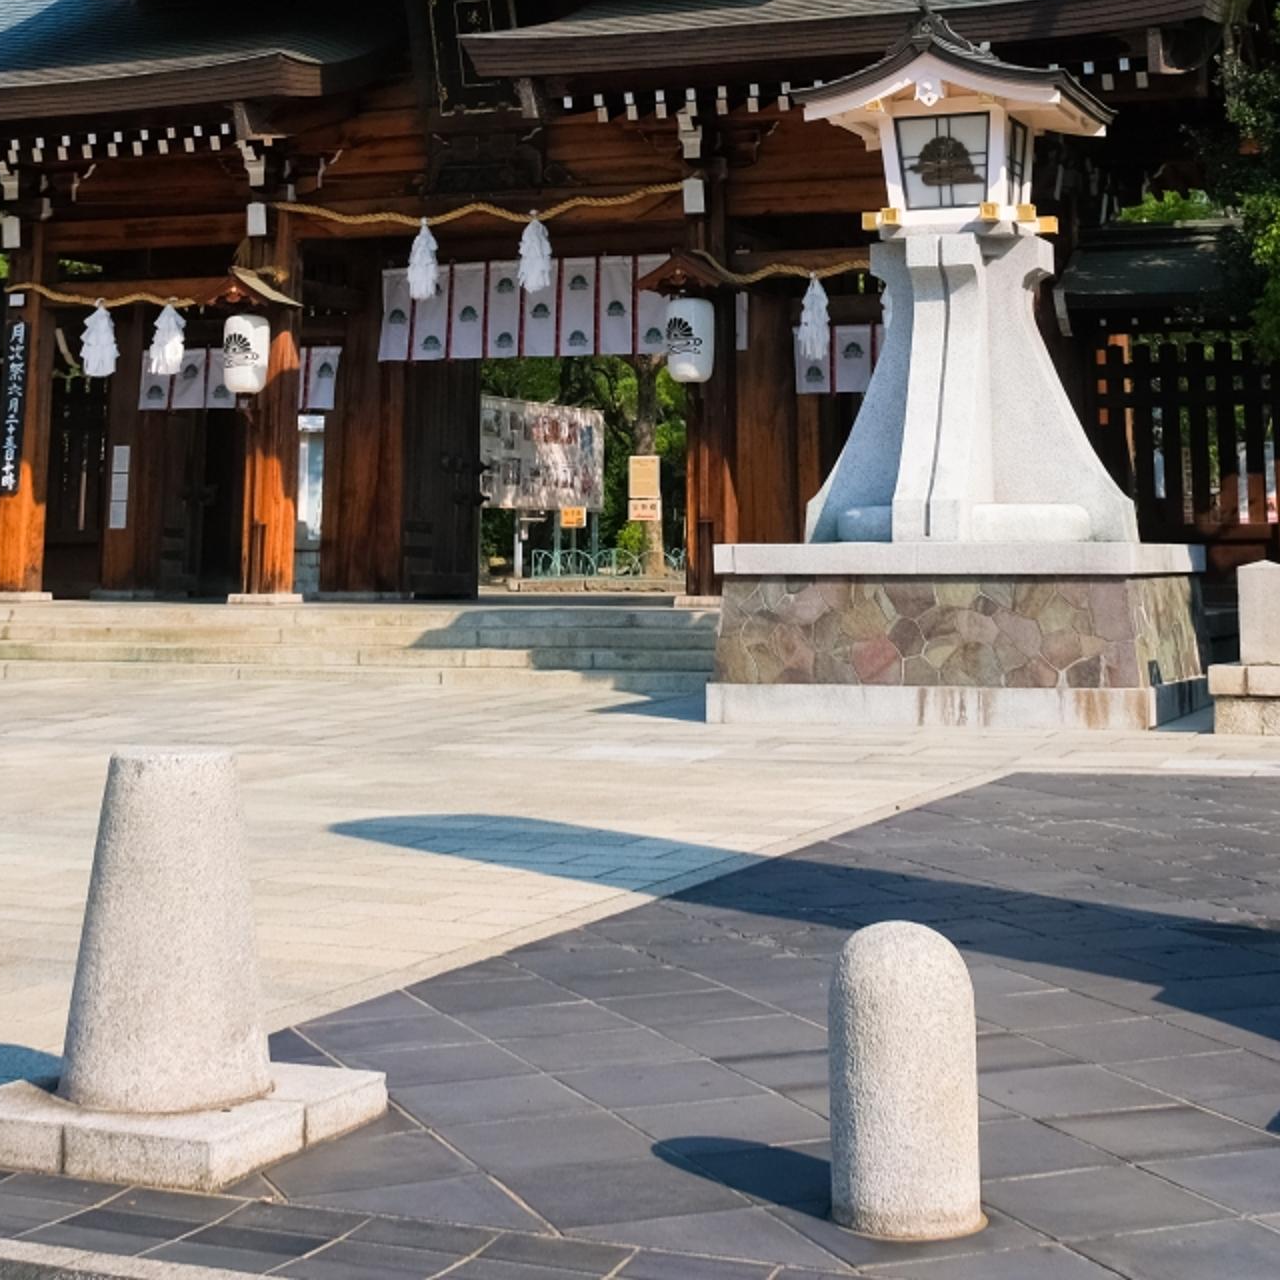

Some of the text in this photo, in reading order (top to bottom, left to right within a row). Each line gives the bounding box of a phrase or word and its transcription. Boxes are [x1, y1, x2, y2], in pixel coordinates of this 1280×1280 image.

[1, 321, 26, 491] 月次祭六月二十五日十時
